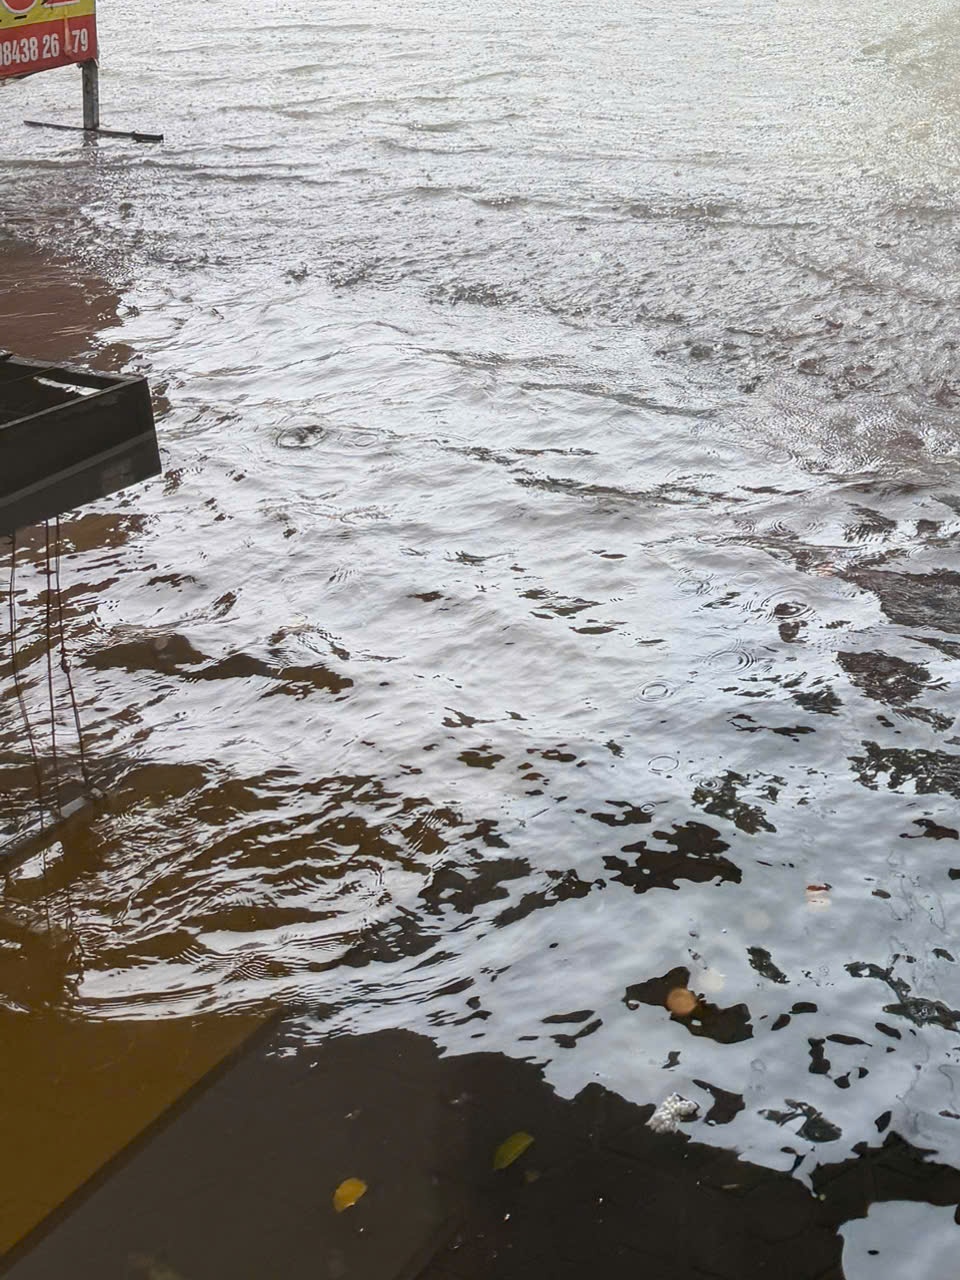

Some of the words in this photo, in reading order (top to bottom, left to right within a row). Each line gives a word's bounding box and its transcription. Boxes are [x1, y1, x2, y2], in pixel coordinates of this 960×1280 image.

[0, 36, 39, 67] 8438
[42, 32, 60, 59] 26
[72, 28, 88, 54] 79
